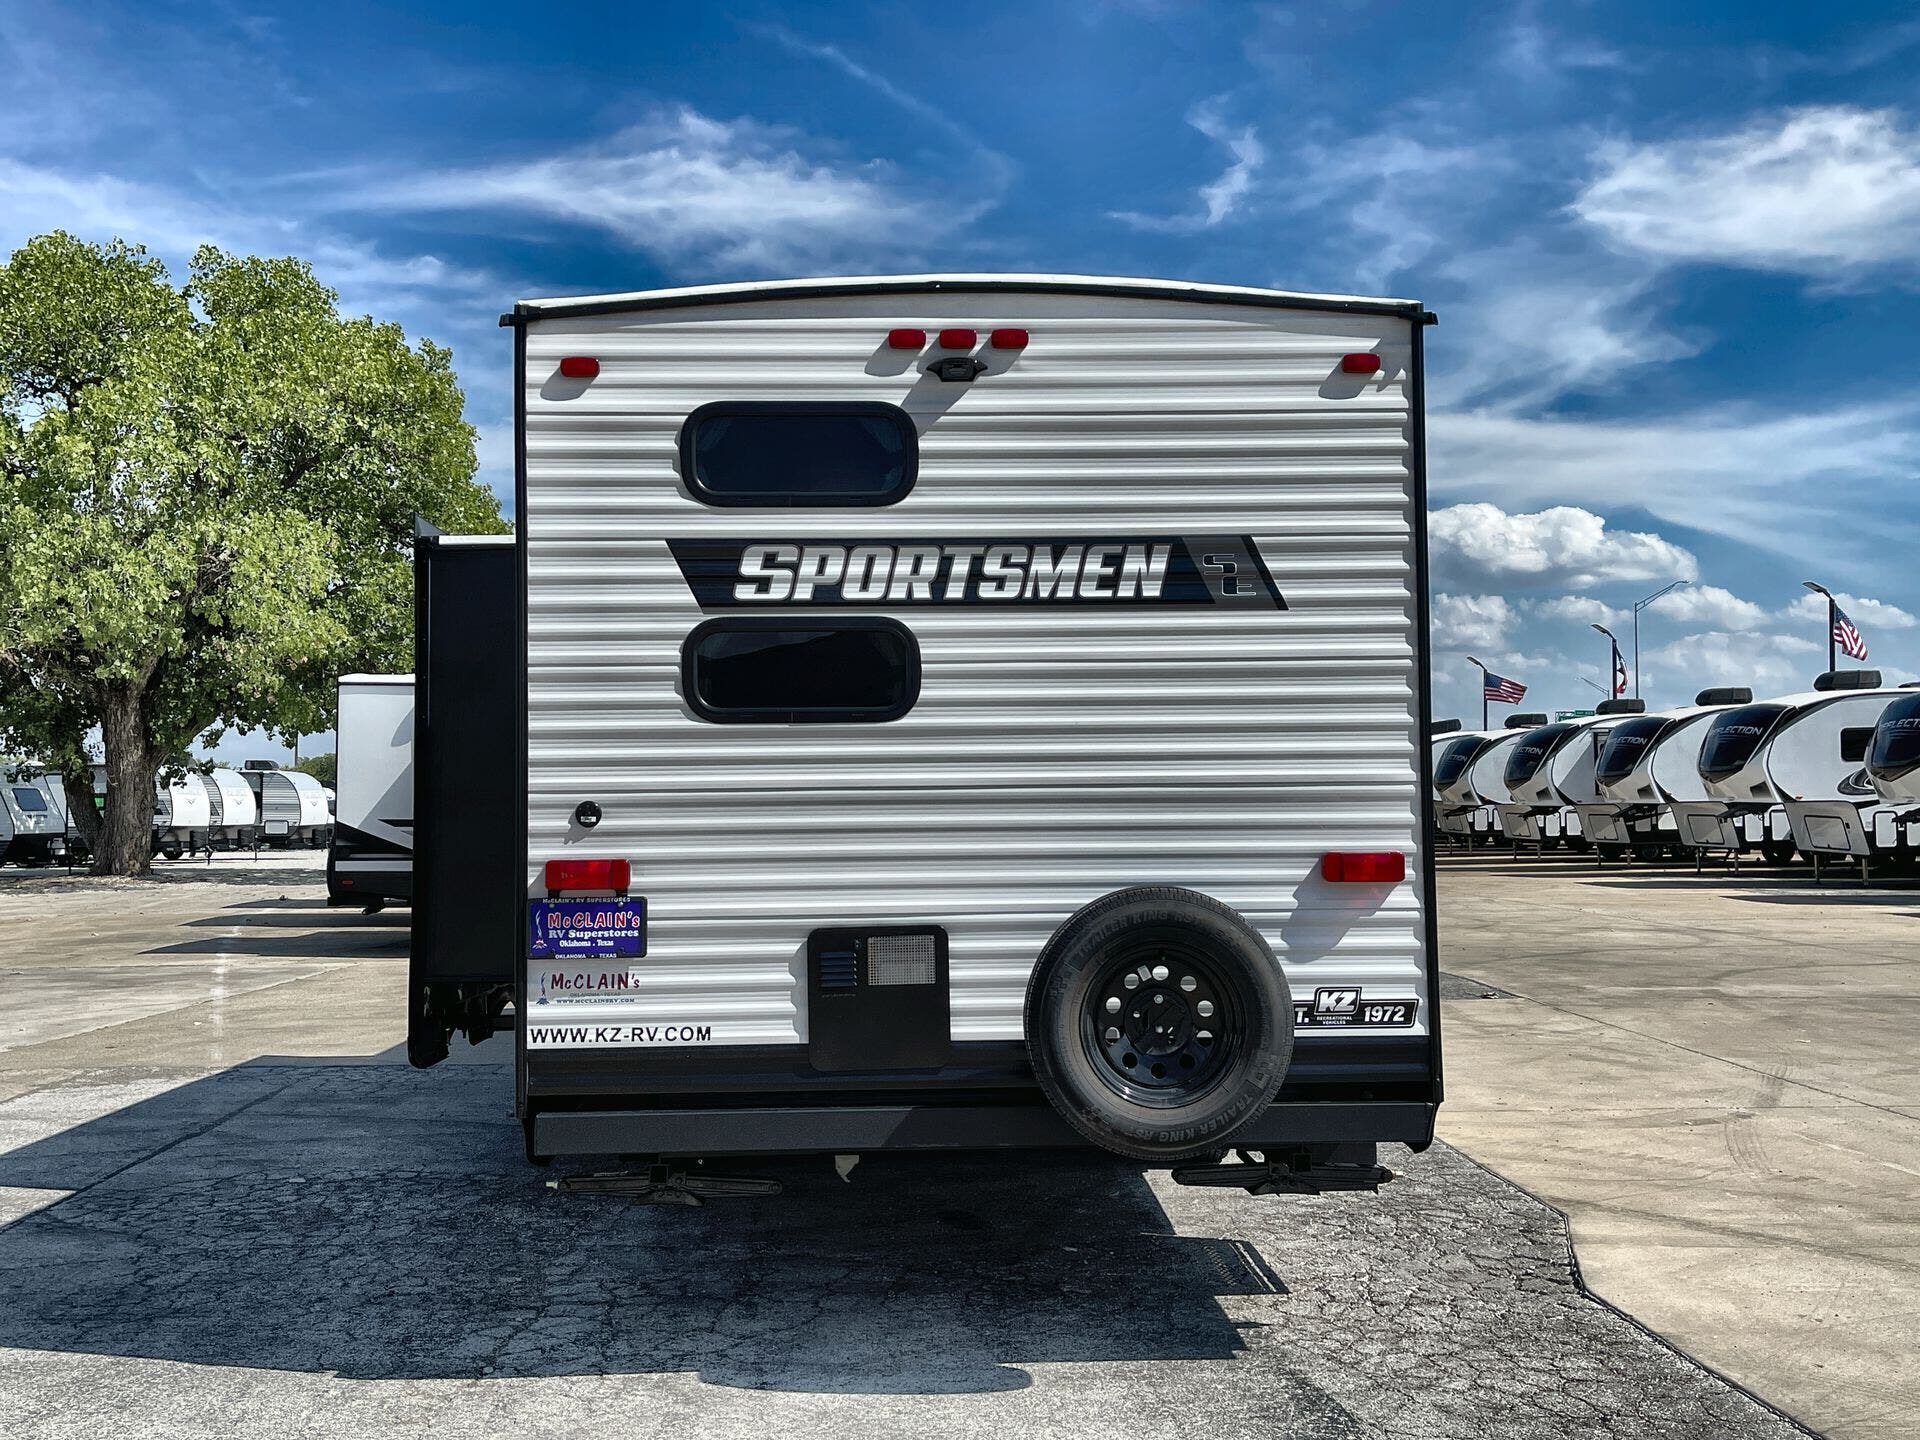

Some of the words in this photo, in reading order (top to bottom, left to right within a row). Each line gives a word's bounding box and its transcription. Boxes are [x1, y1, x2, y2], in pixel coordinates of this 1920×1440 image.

[732, 542, 1172, 601] SPORTSMEN
[547, 911, 641, 928] McCLAIN's
[1132, 910, 1168, 924] KING
[548, 929, 566, 939] RV
[568, 929, 639, 940] Superstores
[551, 972, 640, 990] McCLAIN's
[1318, 991, 1357, 1012] KZ
[1295, 1007, 1309, 1023] T.
[1364, 1006, 1405, 1022] 1972
[530, 1026, 712, 1043] WWW.KZ-RV.COM
[1199, 1094, 1253, 1134] TRAILER
[1159, 1128, 1195, 1142] KING
